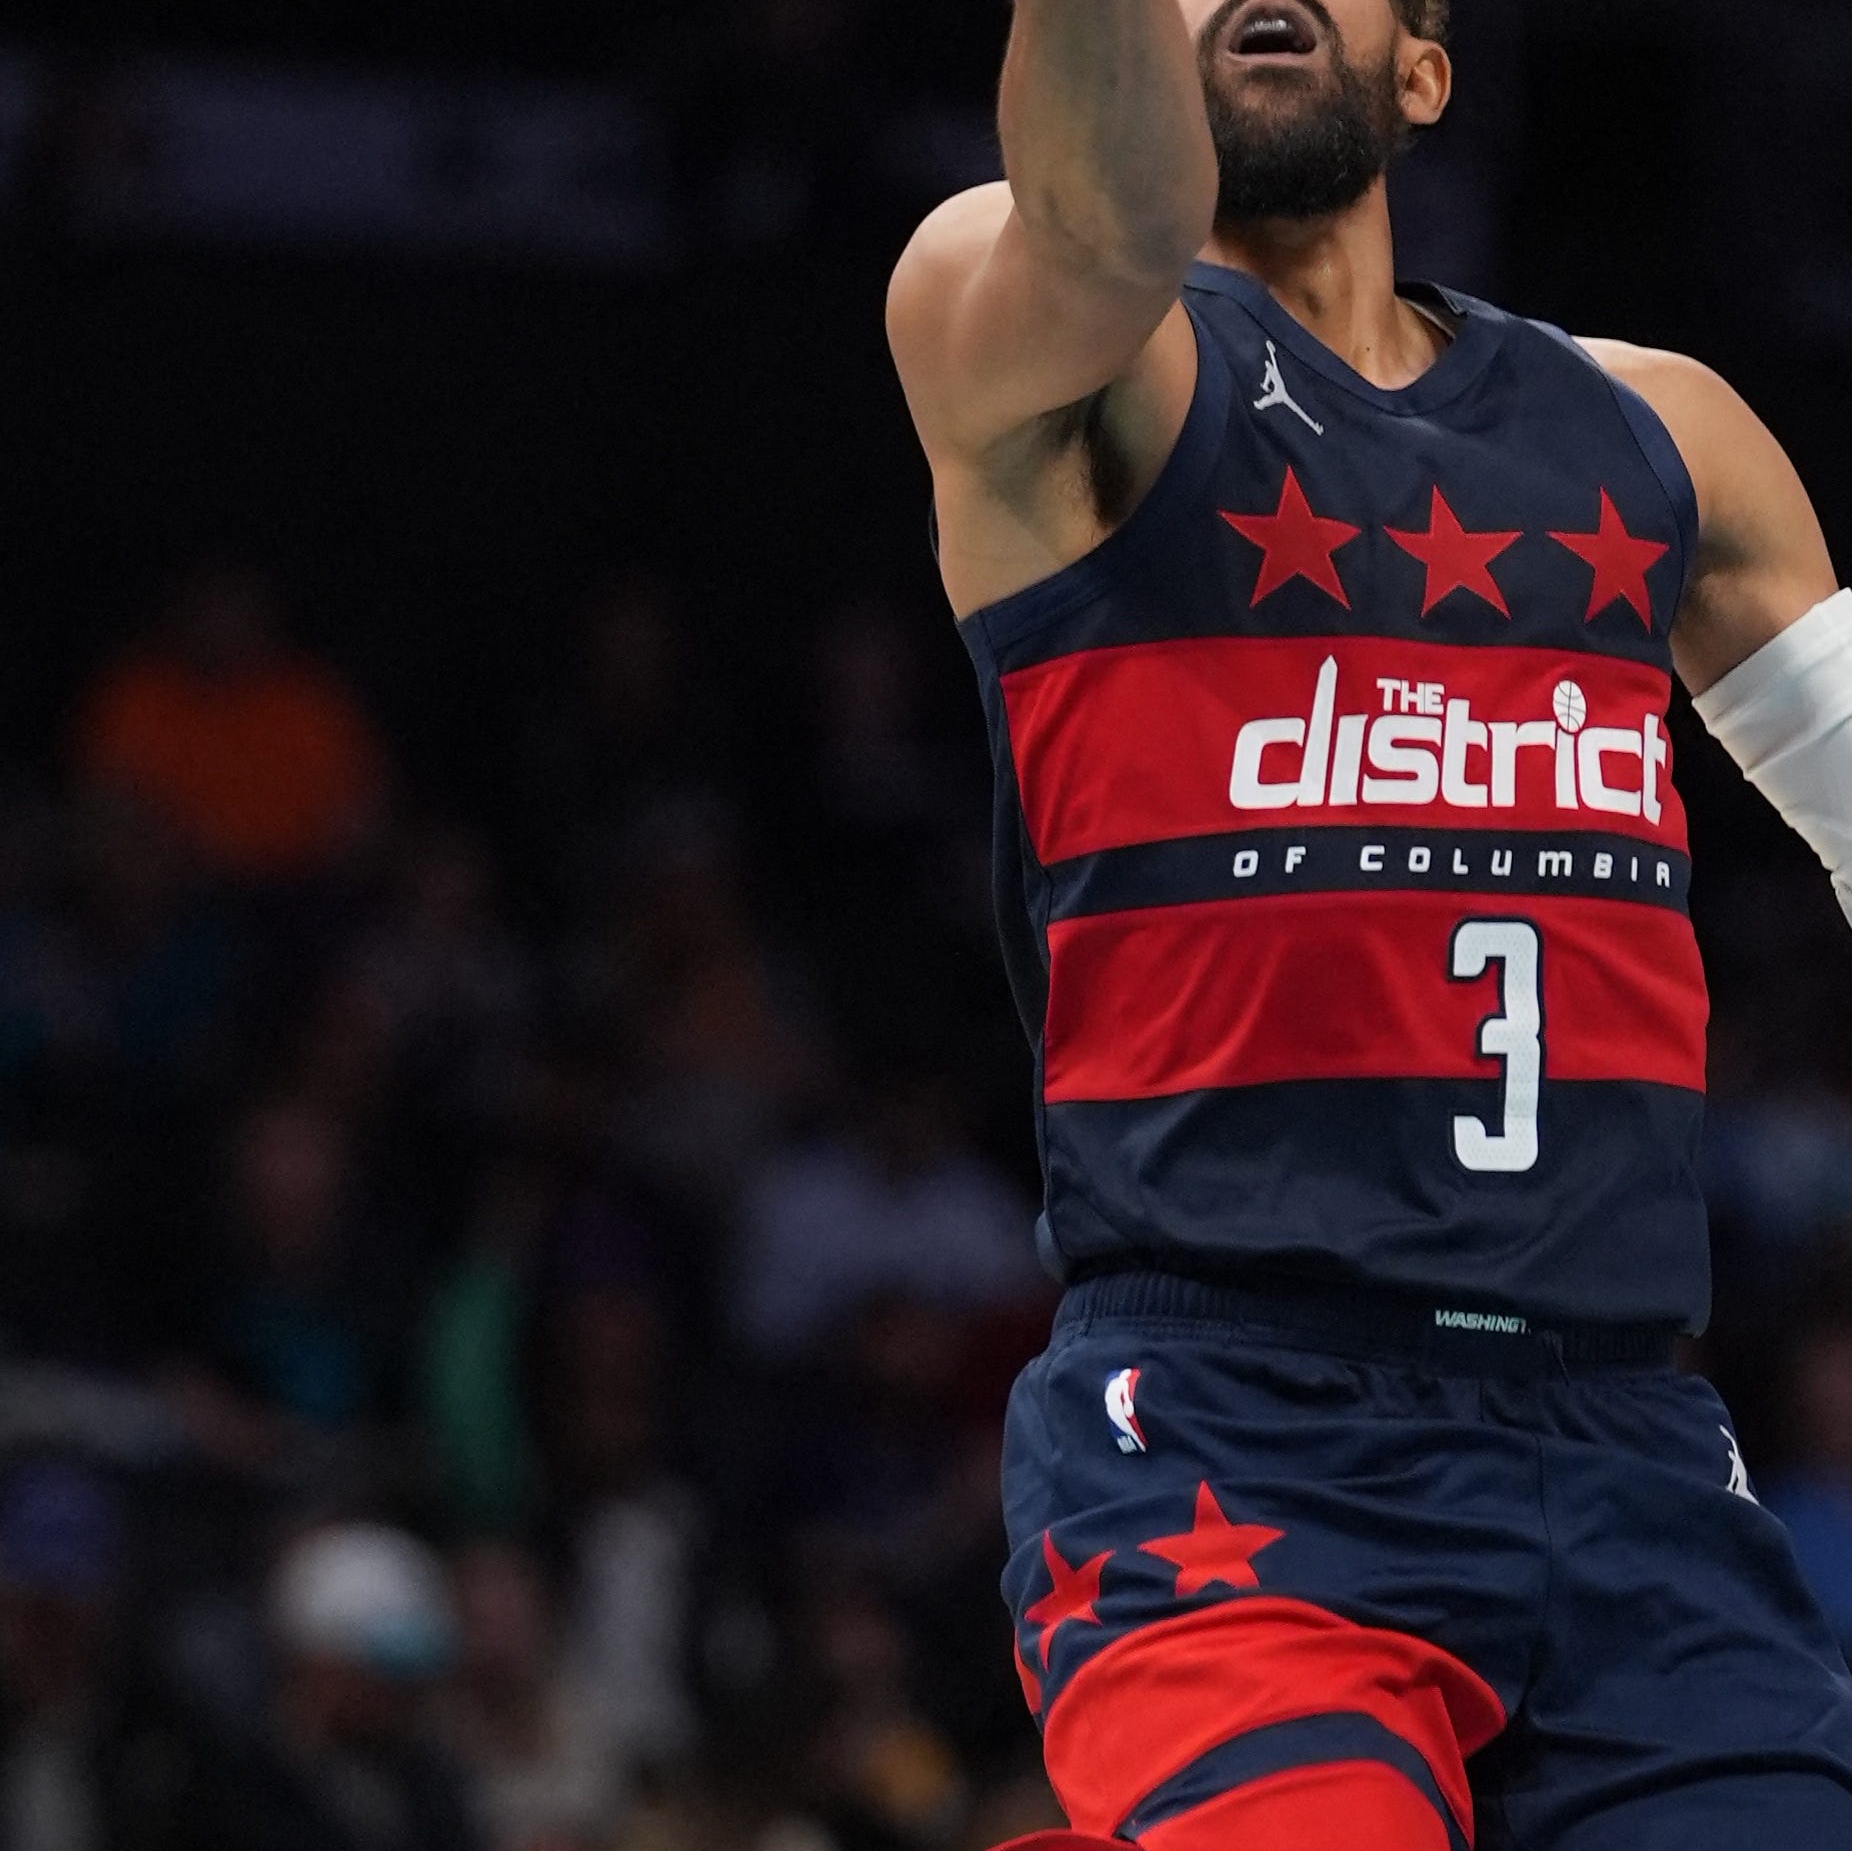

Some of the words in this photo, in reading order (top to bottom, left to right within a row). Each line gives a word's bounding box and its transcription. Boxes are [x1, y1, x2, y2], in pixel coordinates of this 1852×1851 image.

[1229, 654, 1667, 826] district
[1376, 677, 1445, 715] THE
[1232, 846, 1307, 878] OF
[1359, 845, 1672, 888] COLUMBIA
[1449, 918, 1543, 1174] 3
